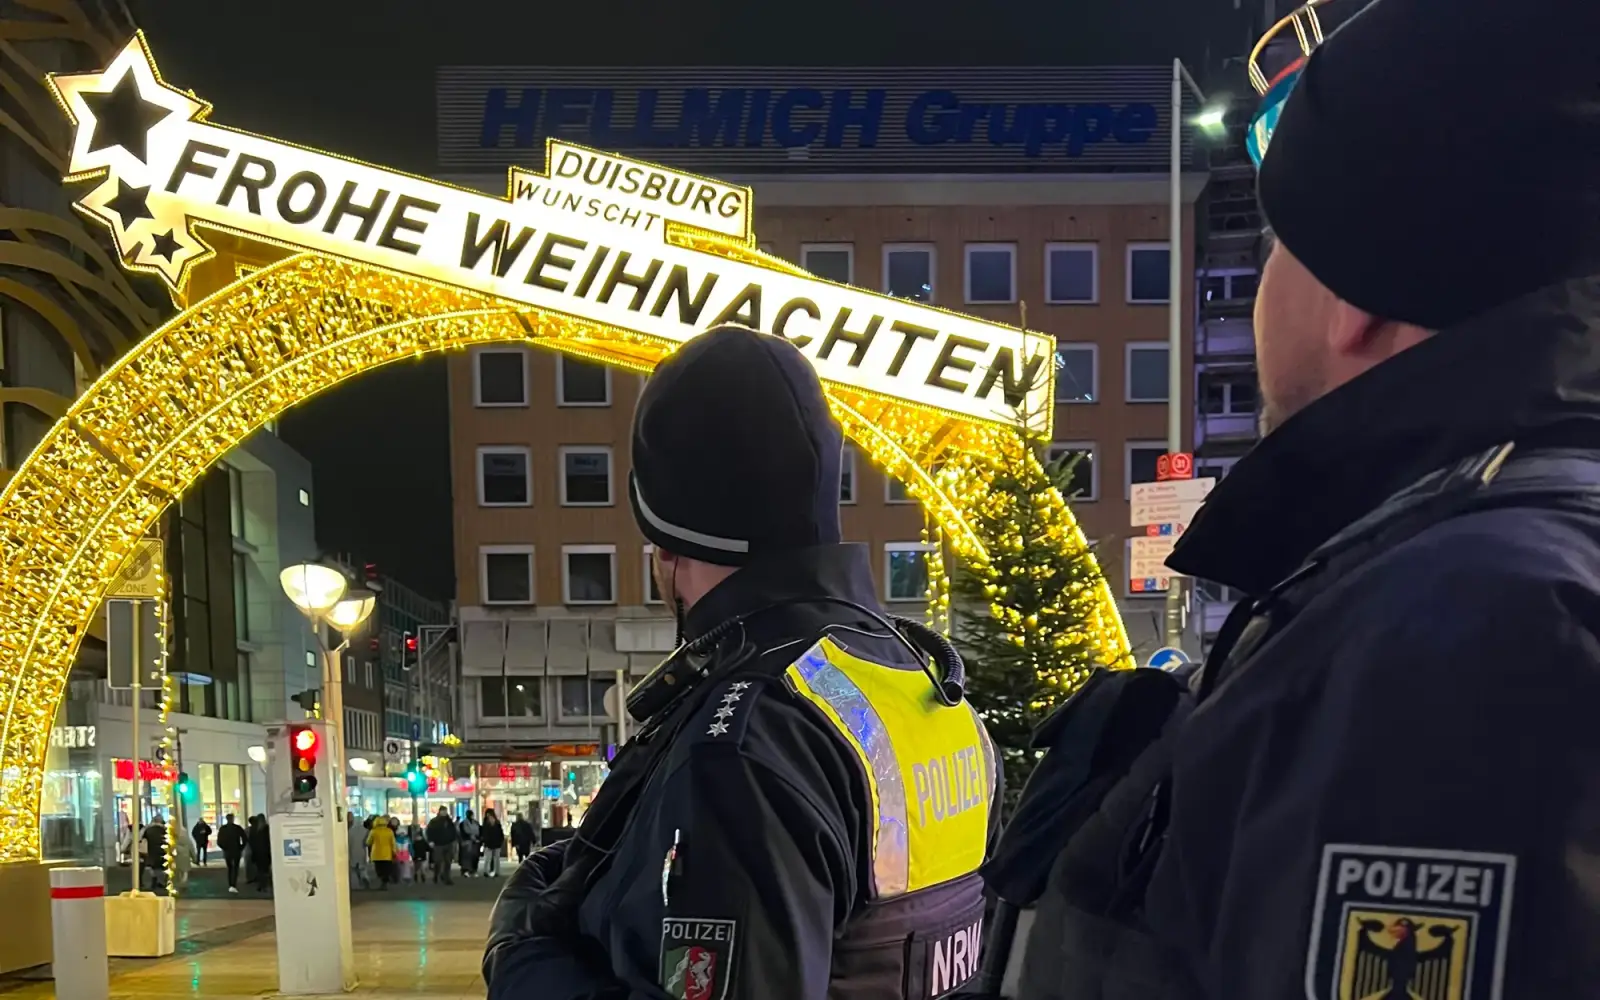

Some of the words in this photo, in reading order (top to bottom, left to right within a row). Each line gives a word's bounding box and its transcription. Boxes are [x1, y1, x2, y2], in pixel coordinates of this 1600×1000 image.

[480, 87, 886, 148] HELLMICH
[904, 89, 1158, 158] Gruppe
[555, 150, 742, 218] DUISBURG
[164, 139, 441, 255] FROHE
[459, 211, 1045, 407] WEIHNACHTEN
[120, 583, 148, 593] ZONE
[912, 743, 984, 828] POLIZEI
[1336, 858, 1494, 907] POLIZEI
[663, 922, 731, 941] POLIZEI
[931, 918, 983, 996] NRW
